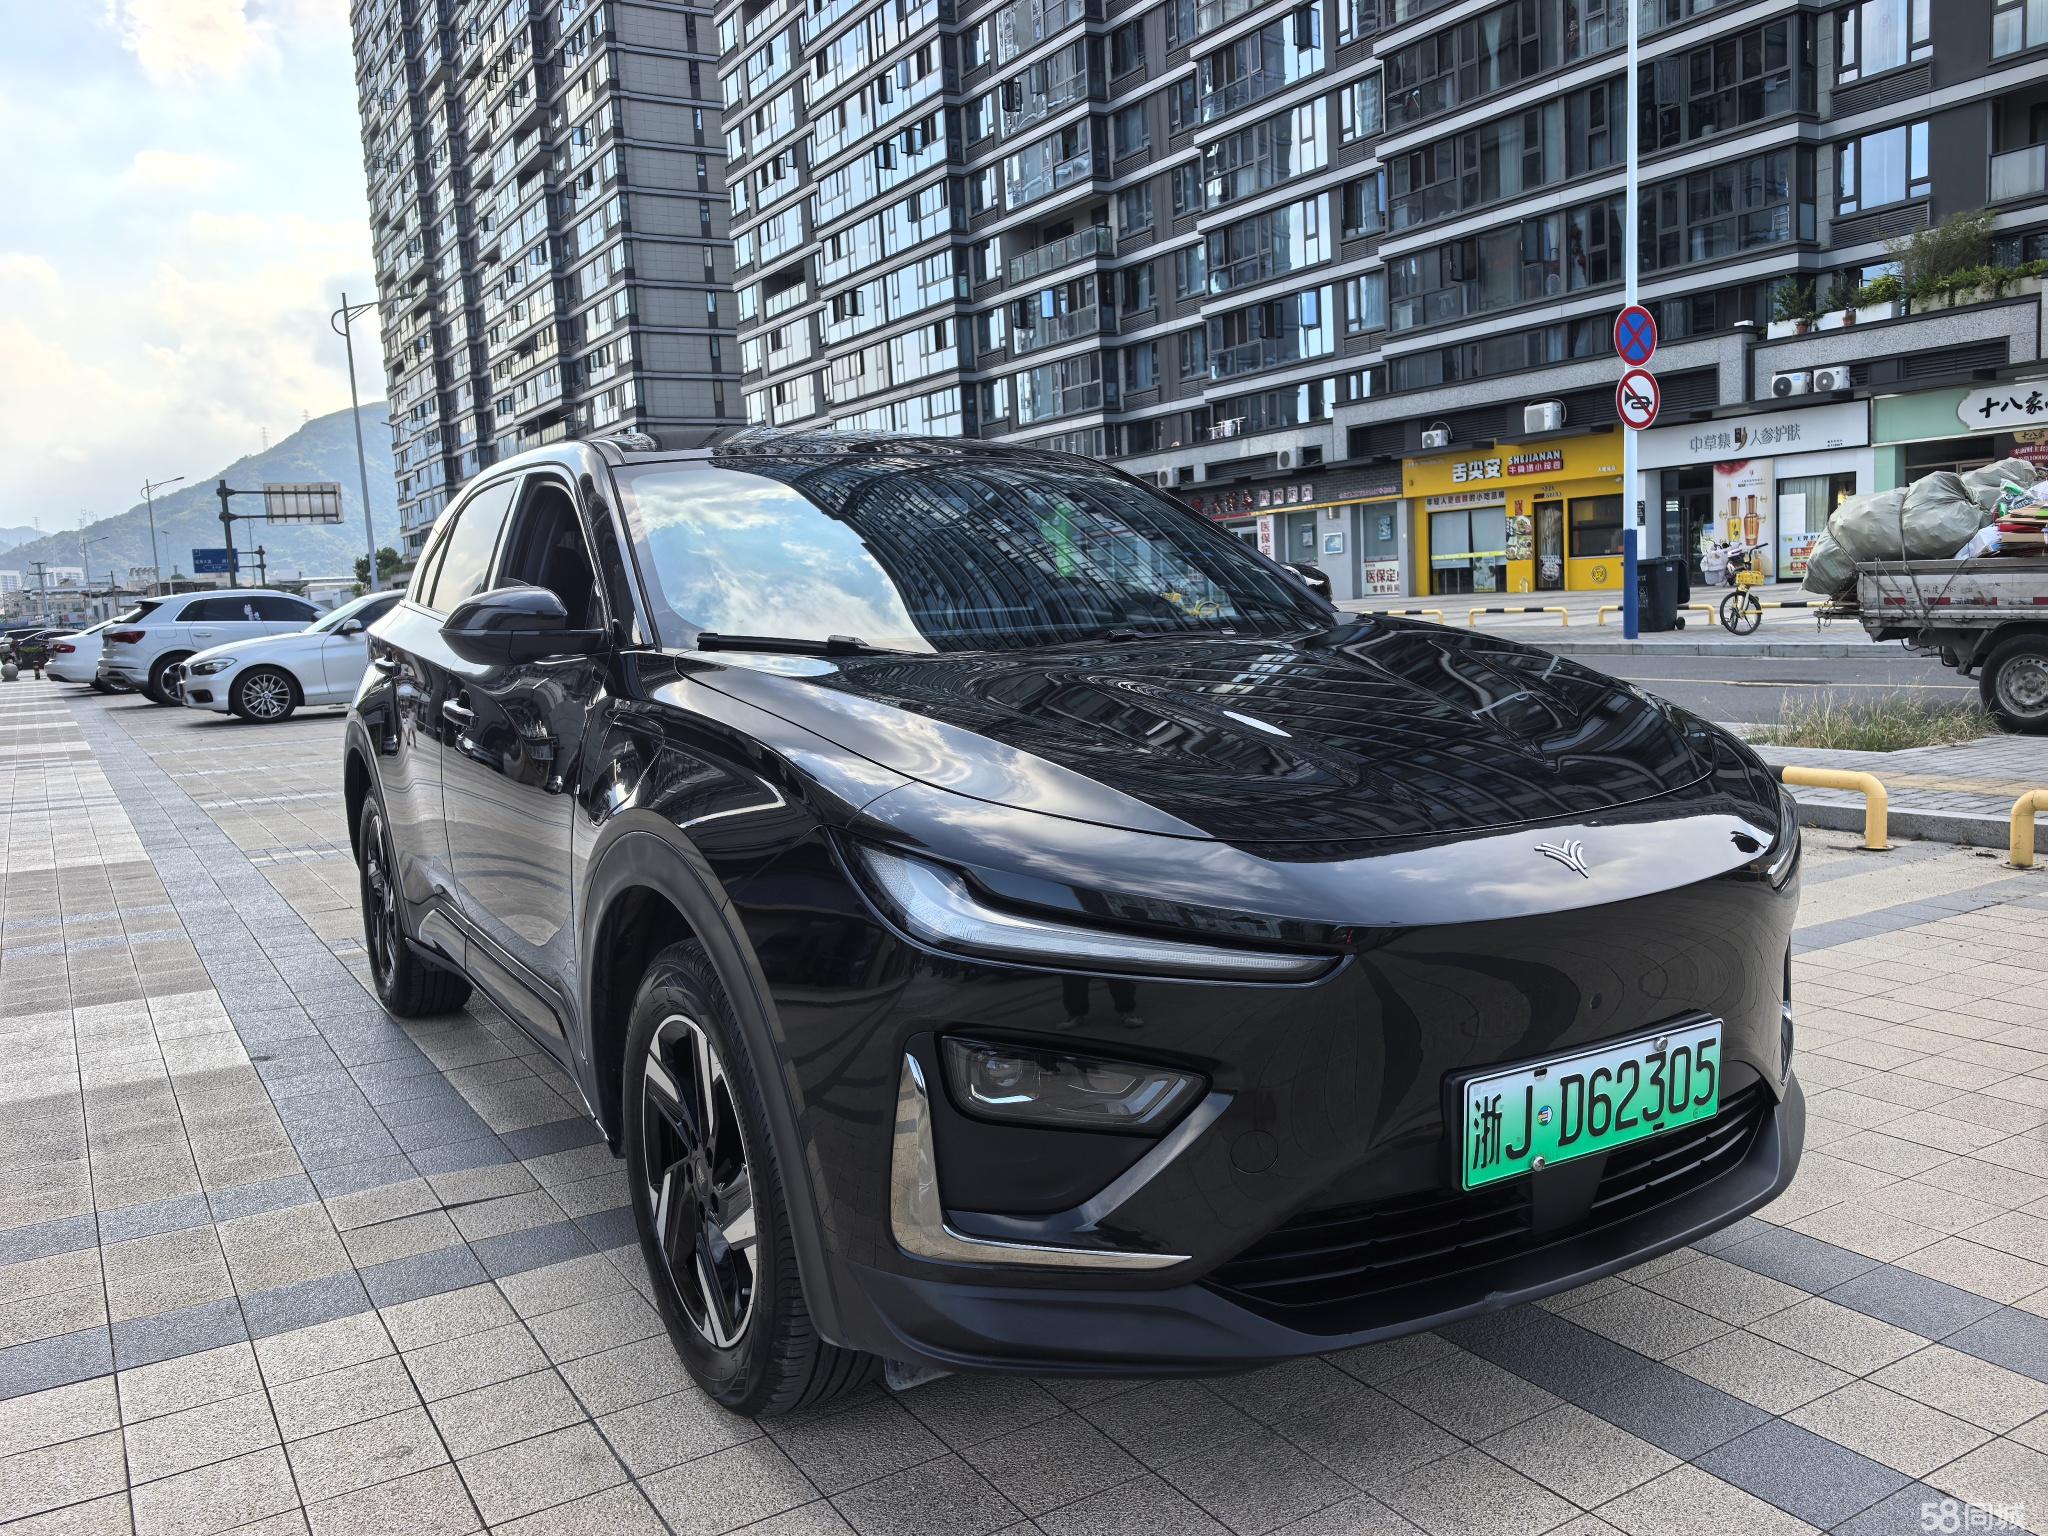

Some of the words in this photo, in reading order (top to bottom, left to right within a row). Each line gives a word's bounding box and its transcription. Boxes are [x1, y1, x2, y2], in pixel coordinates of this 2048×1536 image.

[1979, 391, 2048, 418] 十八家
[1690, 433, 1731, 452] 中草集
[1750, 424, 1800, 446] 人参护肤
[1508, 450, 1561, 465] SHEJIANAN
[1452, 458, 1502, 483] 舌尖安
[1366, 568, 1399, 583] 医保定
